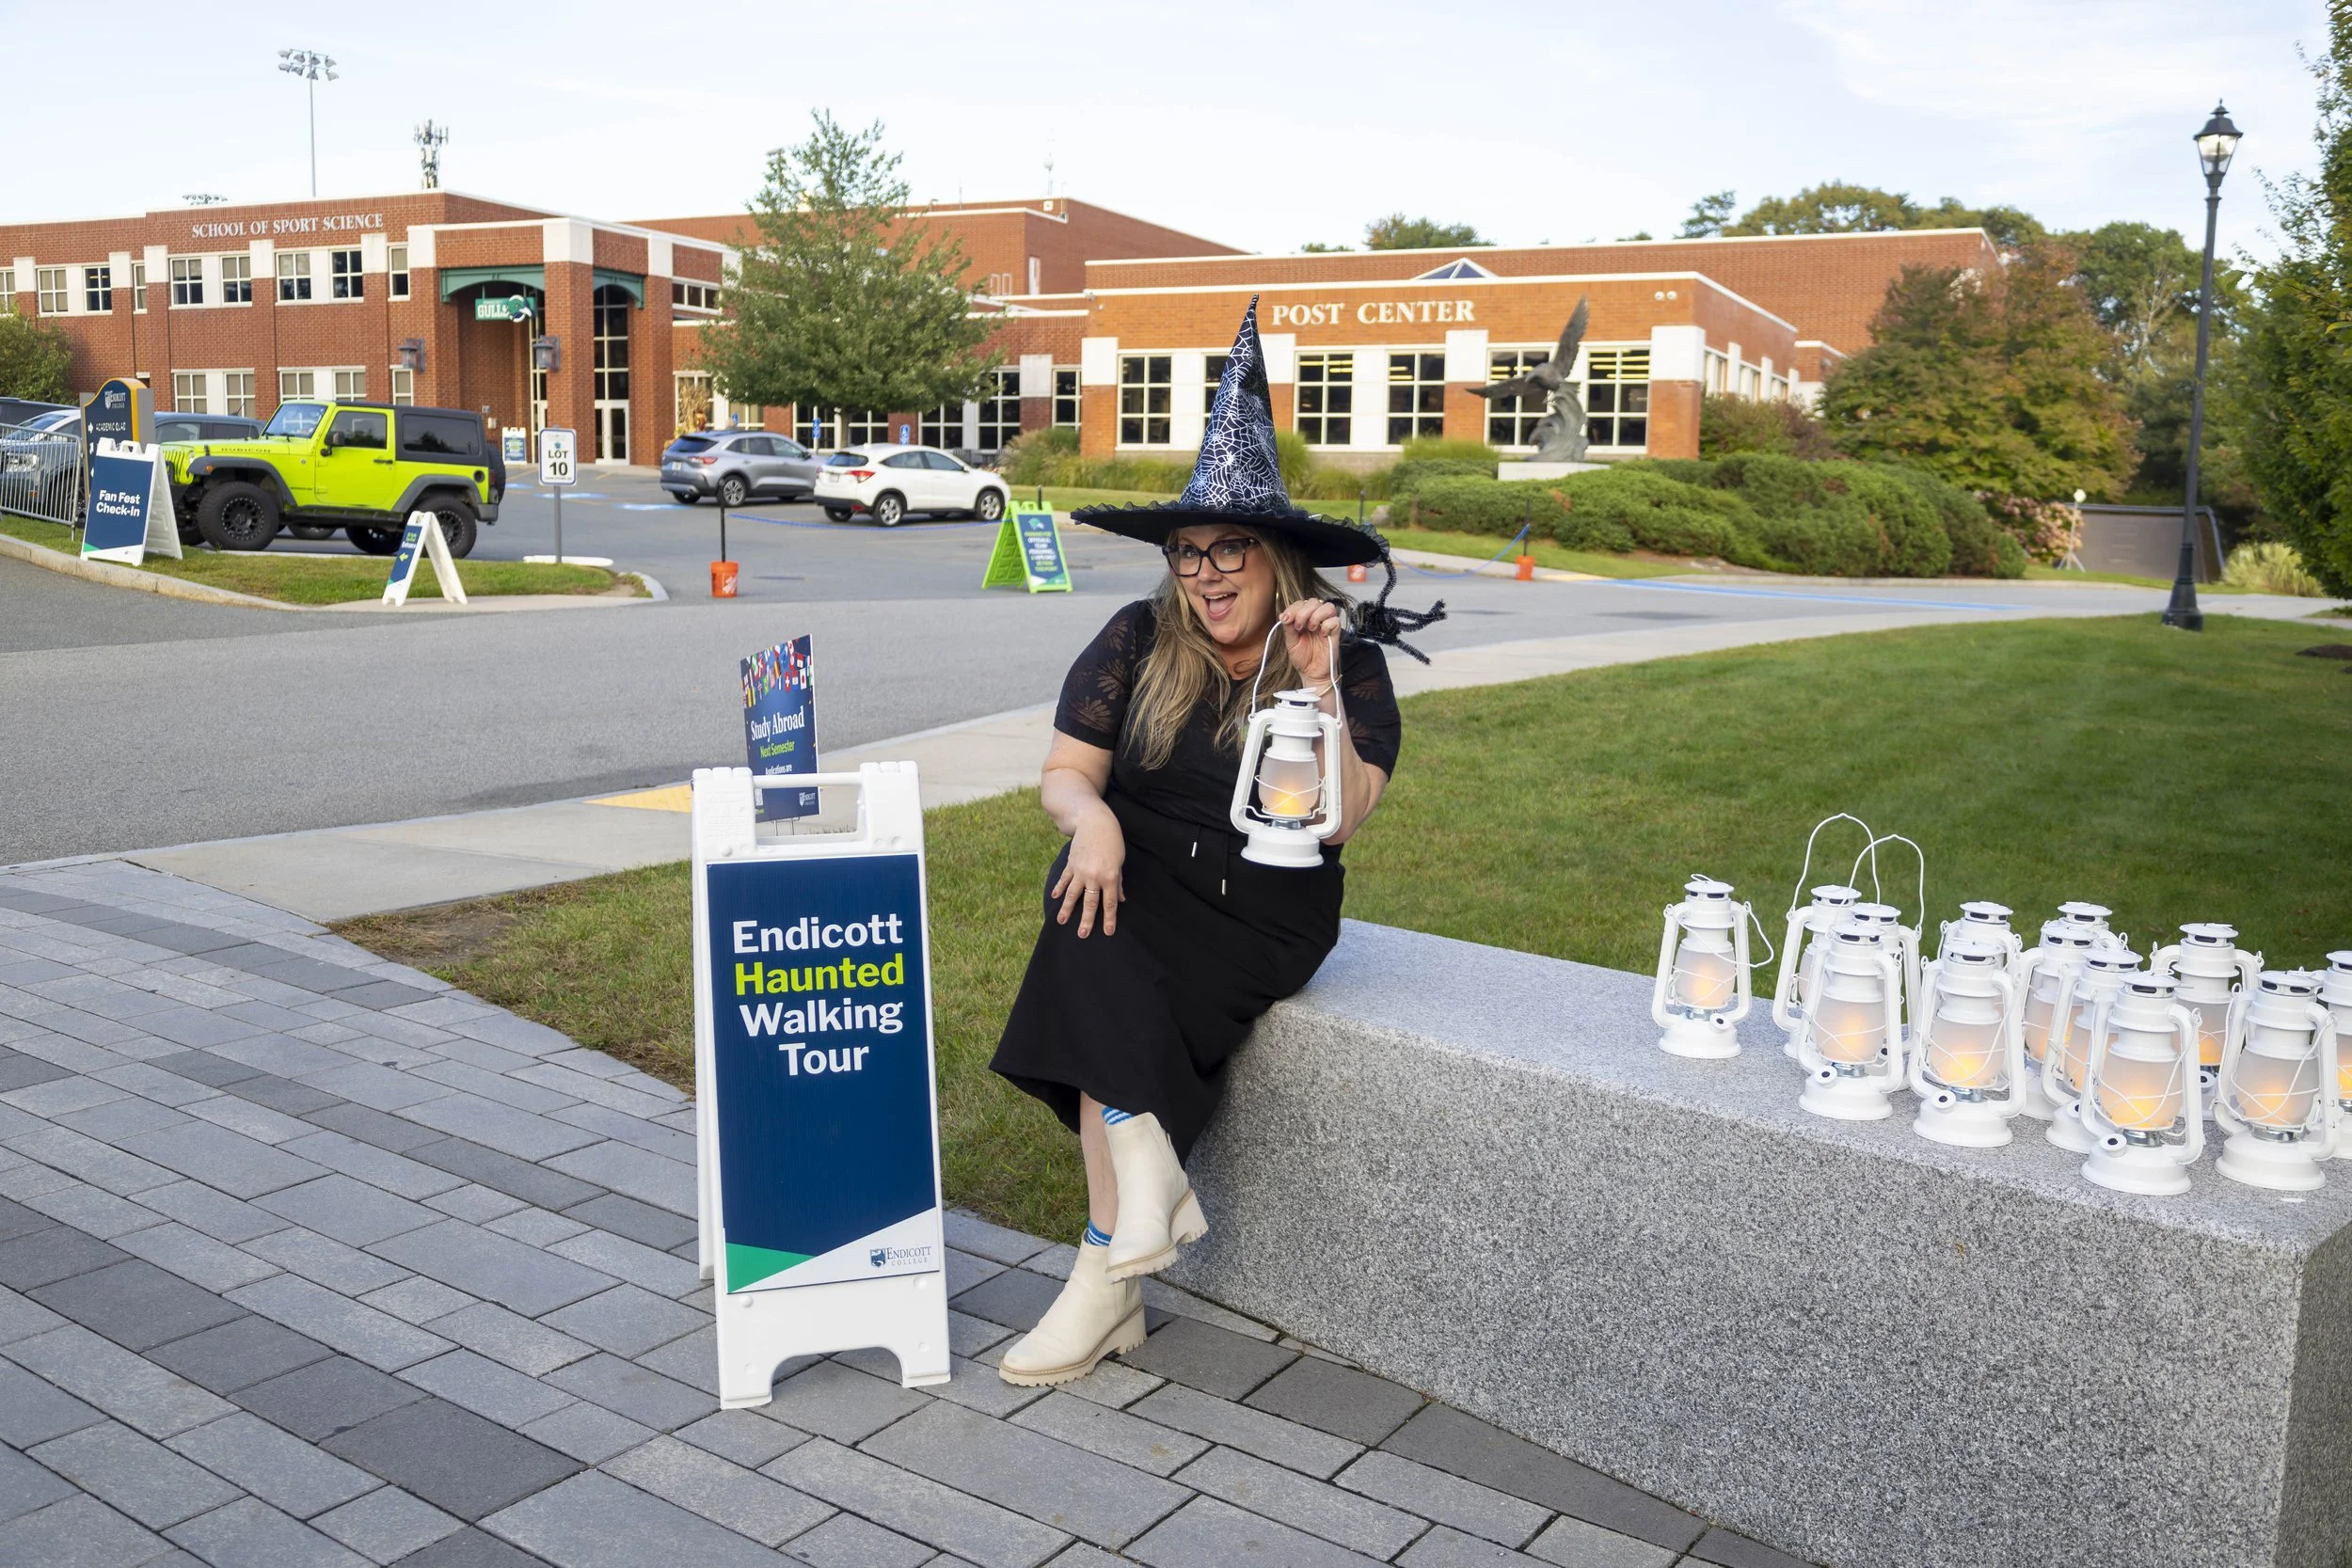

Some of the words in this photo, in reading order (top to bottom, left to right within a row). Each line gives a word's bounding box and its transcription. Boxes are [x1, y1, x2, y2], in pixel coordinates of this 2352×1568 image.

[192, 221, 247, 238] SCHOOL
[250, 220, 269, 235] OF
[273, 217, 319, 234] SPORT
[323, 213, 384, 231] SCIENCE
[1271, 302, 1345, 325] POST
[1357, 300, 1475, 325] CENTER
[548, 450, 568, 459] LOT
[549, 462, 568, 476] 10
[99, 489, 117, 502] Fan
[119, 492, 141, 505] Fest
[96, 501, 140, 517] Check-In
[751, 716, 771, 742] Study
[772, 705, 805, 735] Abroad
[760, 744, 771, 758] Next
[771, 739, 795, 755] Semester
[733, 913, 903, 954] Endicott
[735, 953, 904, 996] Haunted
[739, 997, 903, 1037] Walking
[778, 1042, 869, 1076] Tour
[886, 1246, 932, 1260] ENDICOTT
[891, 1257, 928, 1266] COLLEGE
